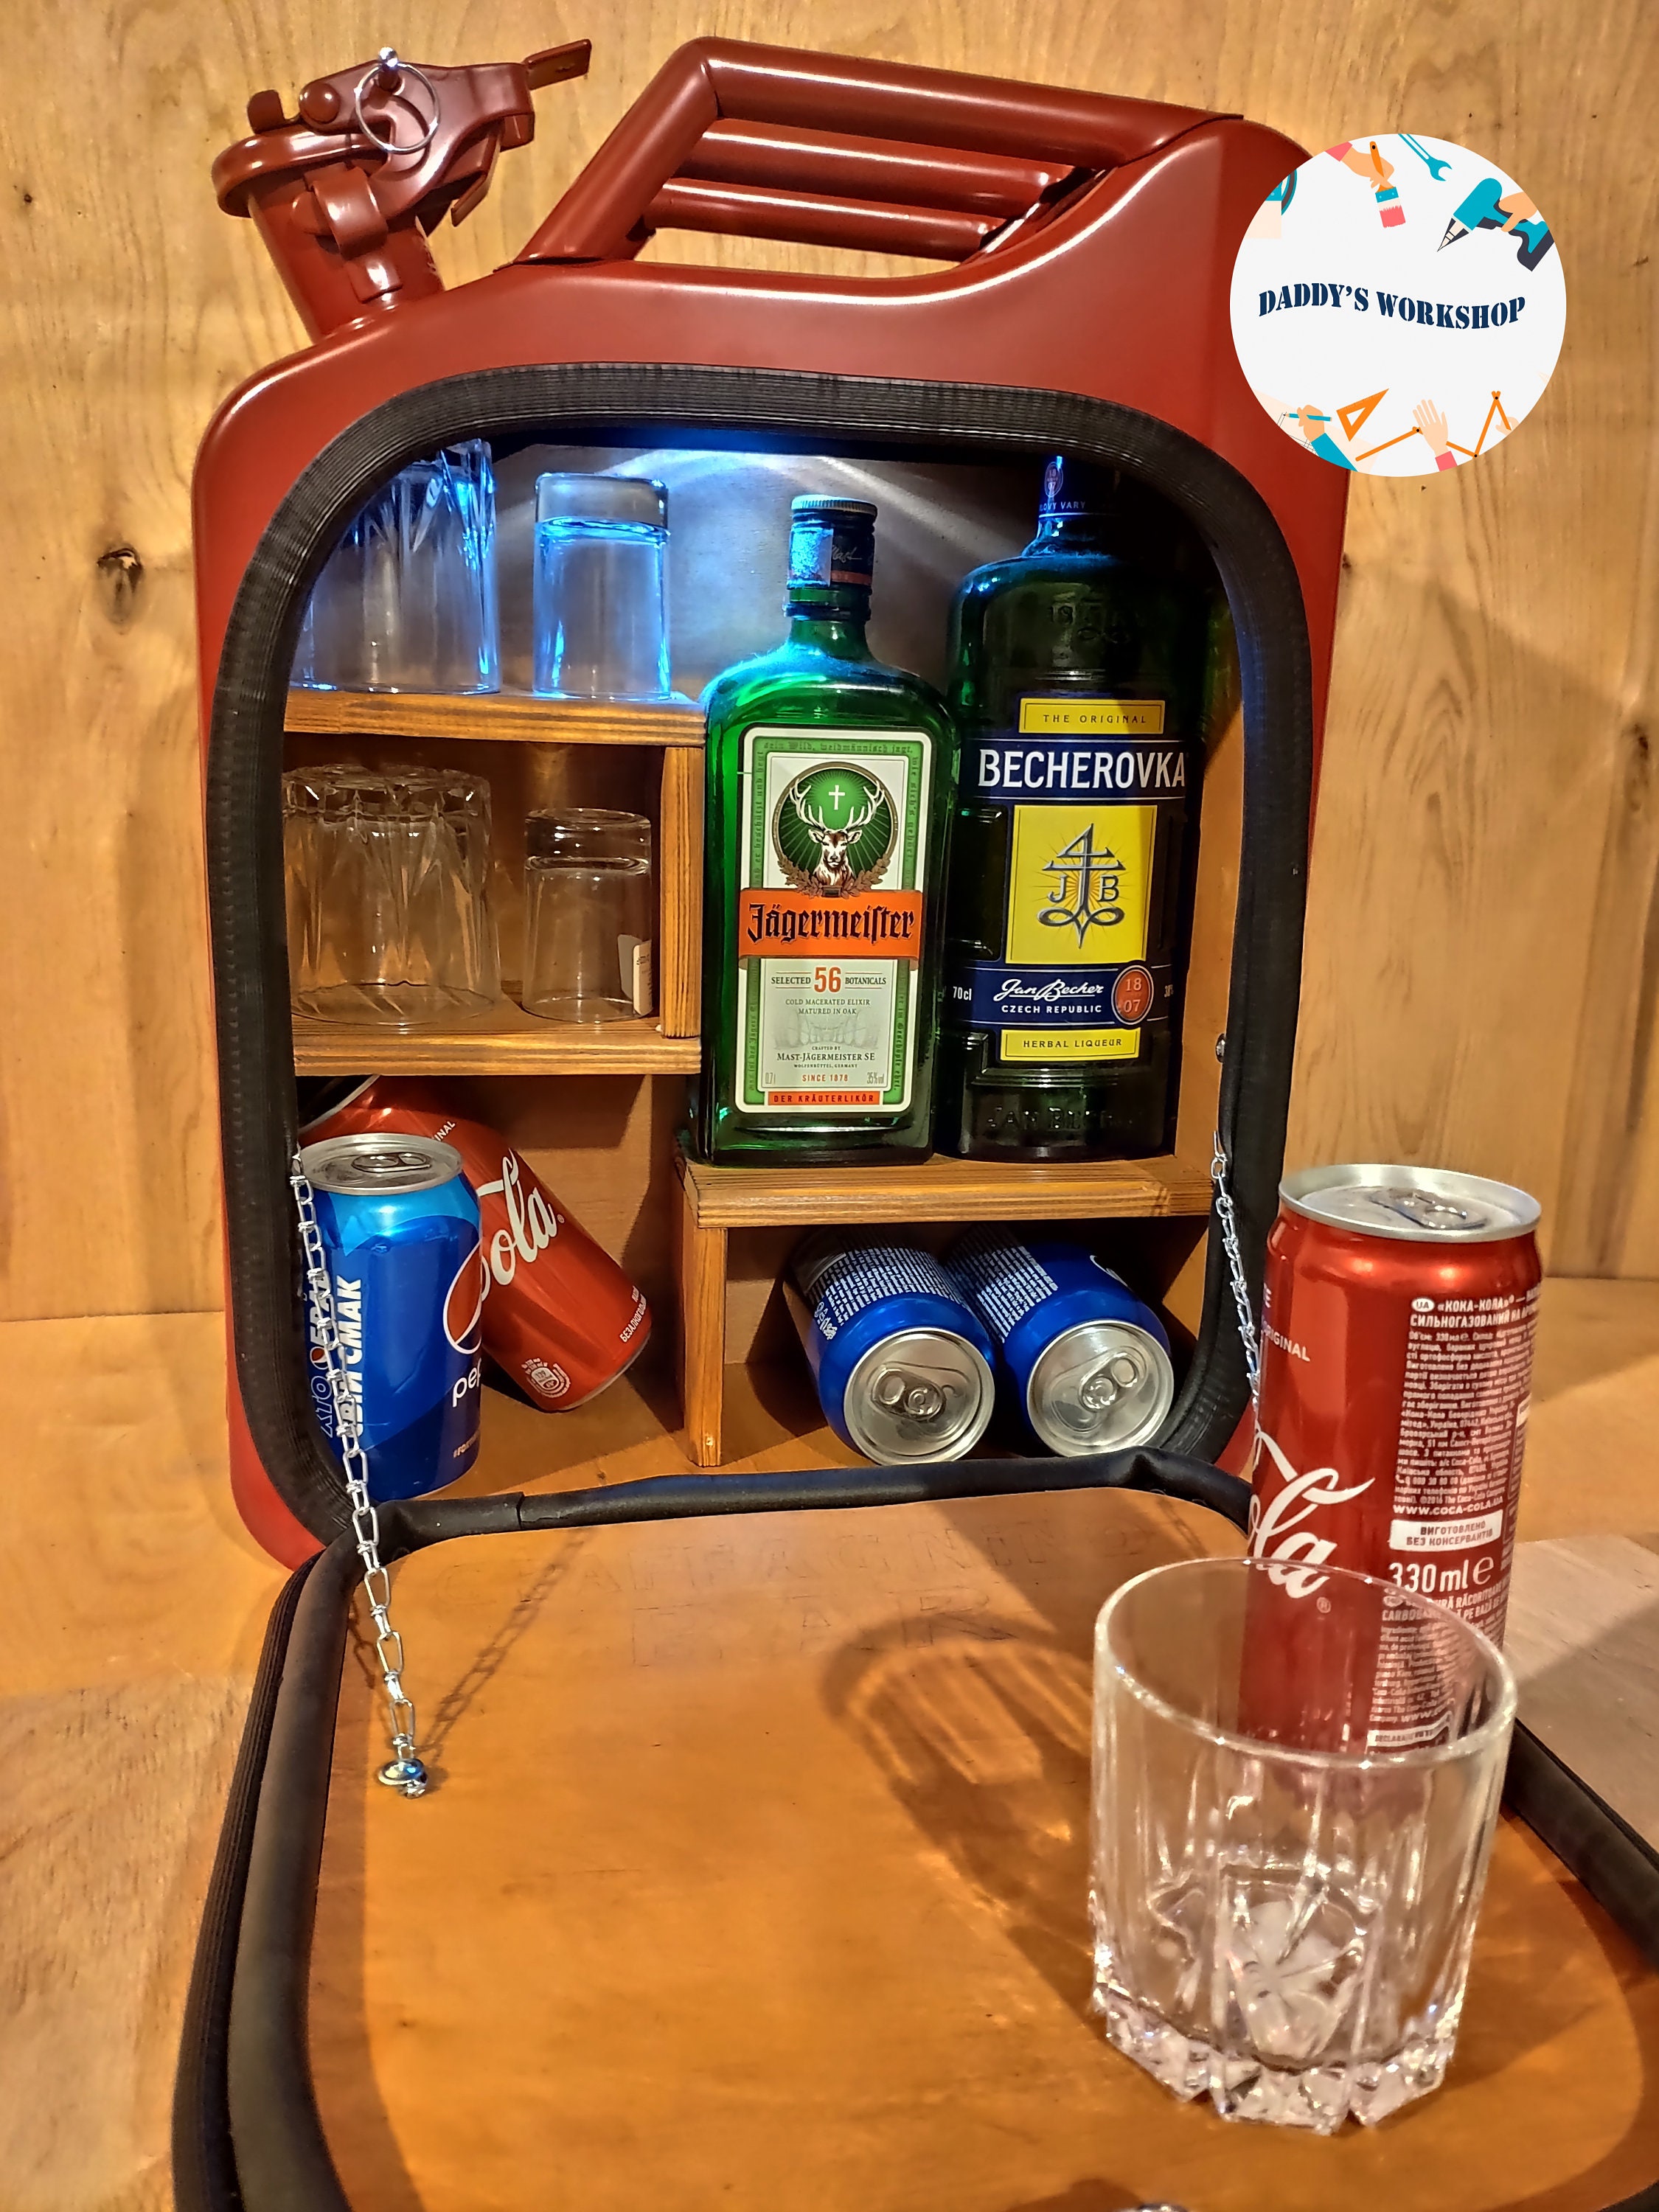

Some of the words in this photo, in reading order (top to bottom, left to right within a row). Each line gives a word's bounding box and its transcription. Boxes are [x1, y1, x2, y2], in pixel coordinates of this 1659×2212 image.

[1060, 501, 1086, 510] VARY
[1043, 714, 1070, 723] THE
[1079, 714, 1147, 724] ORIGINAL
[977, 748, 1186, 789] BECHEROVKA
[771, 976, 811, 985] SELECTED
[813, 967, 842, 992] 56
[844, 977, 887, 985] BOTANICALS
[953, 986, 973, 1001] 70cl
[993, 978, 1037, 1002] Jan
[1034, 978, 1105, 1002] Becher
[1125, 978, 1142, 992] 18
[1001, 1004, 1041, 1014] CZECH
[1046, 1004, 1103, 1014] REPUBLIC
[1122, 999, 1141, 1014] 07
[1023, 1039, 1069, 1048] HERBAL
[1074, 1038, 1122, 1048] LIQUEUR
[864, 1052, 875, 1060] SE
[801, 1074, 827, 1082] SINCE
[830, 1074, 849, 1082] 1878
[773, 1095, 793, 1103] DER
[798, 1093, 874, 1102] KRÄUTERLIKÖR
[1392, 1495, 1503, 1515] WWW.COCA-COLA.UA
[1419, 1520, 1486, 1536] ВИГОТОВЛЕНО
[1406, 1536, 1426, 1546] БЕЗ
